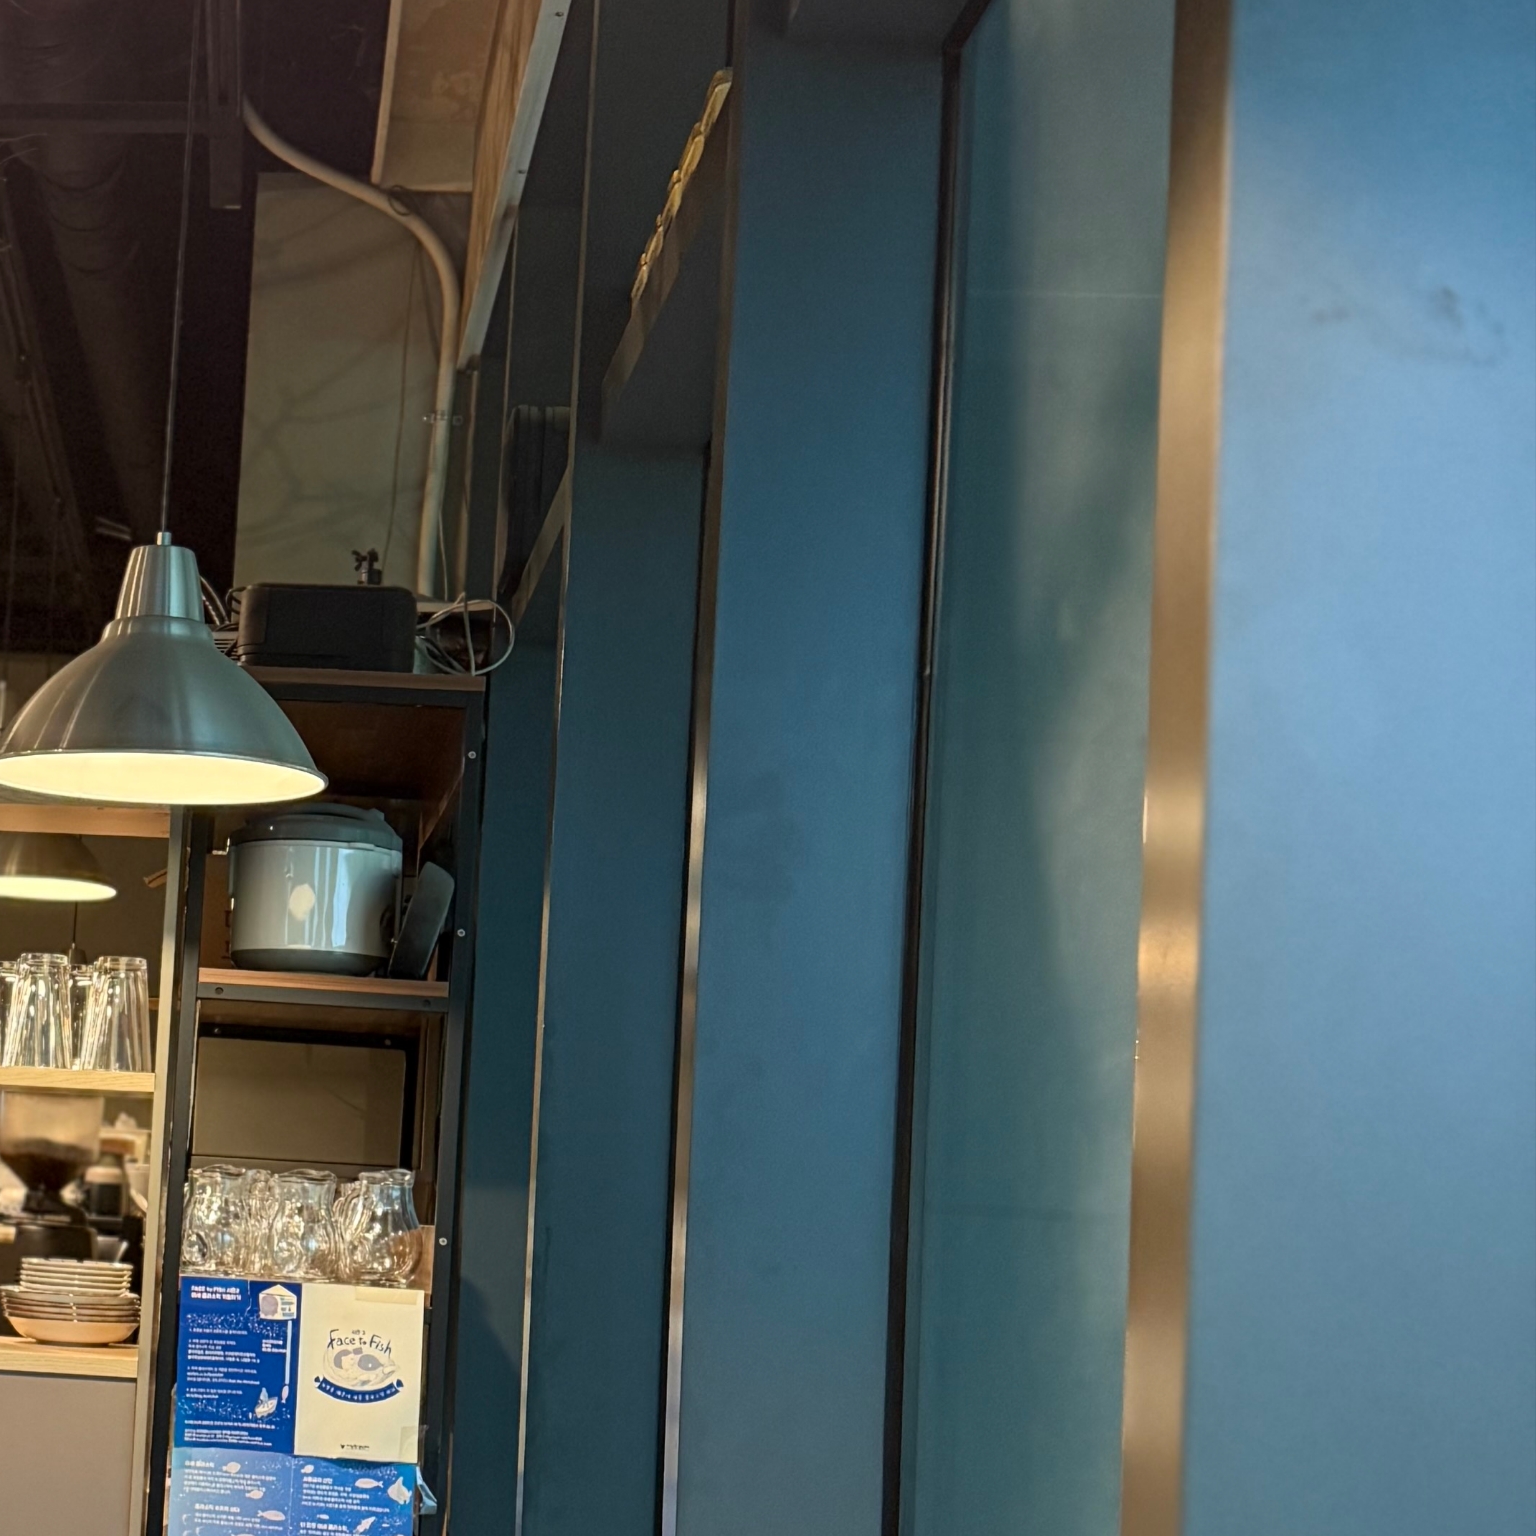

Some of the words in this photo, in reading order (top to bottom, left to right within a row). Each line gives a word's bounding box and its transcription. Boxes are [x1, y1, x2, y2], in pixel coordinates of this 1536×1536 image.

[327, 1328, 356, 1350] Face
[358, 1337, 367, 1346] to
[369, 1334, 392, 1359] Fish
